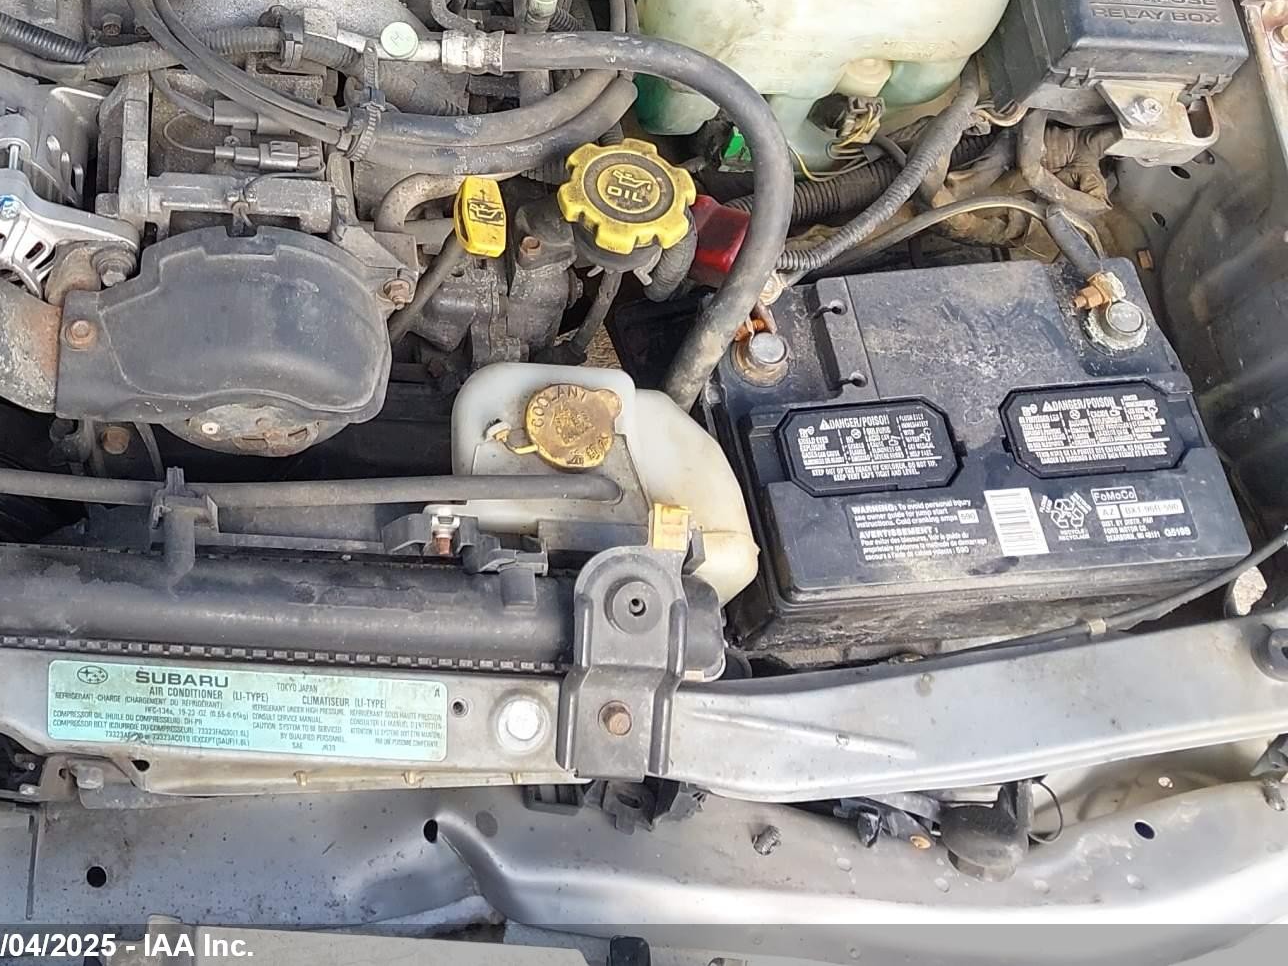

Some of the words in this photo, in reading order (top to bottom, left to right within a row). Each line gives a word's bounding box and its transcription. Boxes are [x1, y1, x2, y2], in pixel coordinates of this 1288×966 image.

[1092, 7, 1162, 20] RELAY
[1171, 11, 1221, 23] BOX
[607, 185, 643, 202] OIL
[1093, 489, 1136, 502] FoMoCo
[852, 503, 898, 515] WARNING:
[925, 499, 953, 510] personal
[887, 511, 905, 521] guide
[915, 510, 933, 520] jump
[895, 516, 912, 525] Cold
[912, 515, 941, 525] cranking
[136, 670, 229, 688] SUBARU
[149, 686, 164, 697] AIR
[167, 687, 224, 701] CONDITIONER
[232, 690, 269, 704] (LI-TYPE)
[277, 682, 297, 692] TOKYO
[298, 684, 318, 694] JAPAN
[302, 695, 349, 707] CLIMATISEUR
[354, 697, 387, 709] (LI-TYPE)
